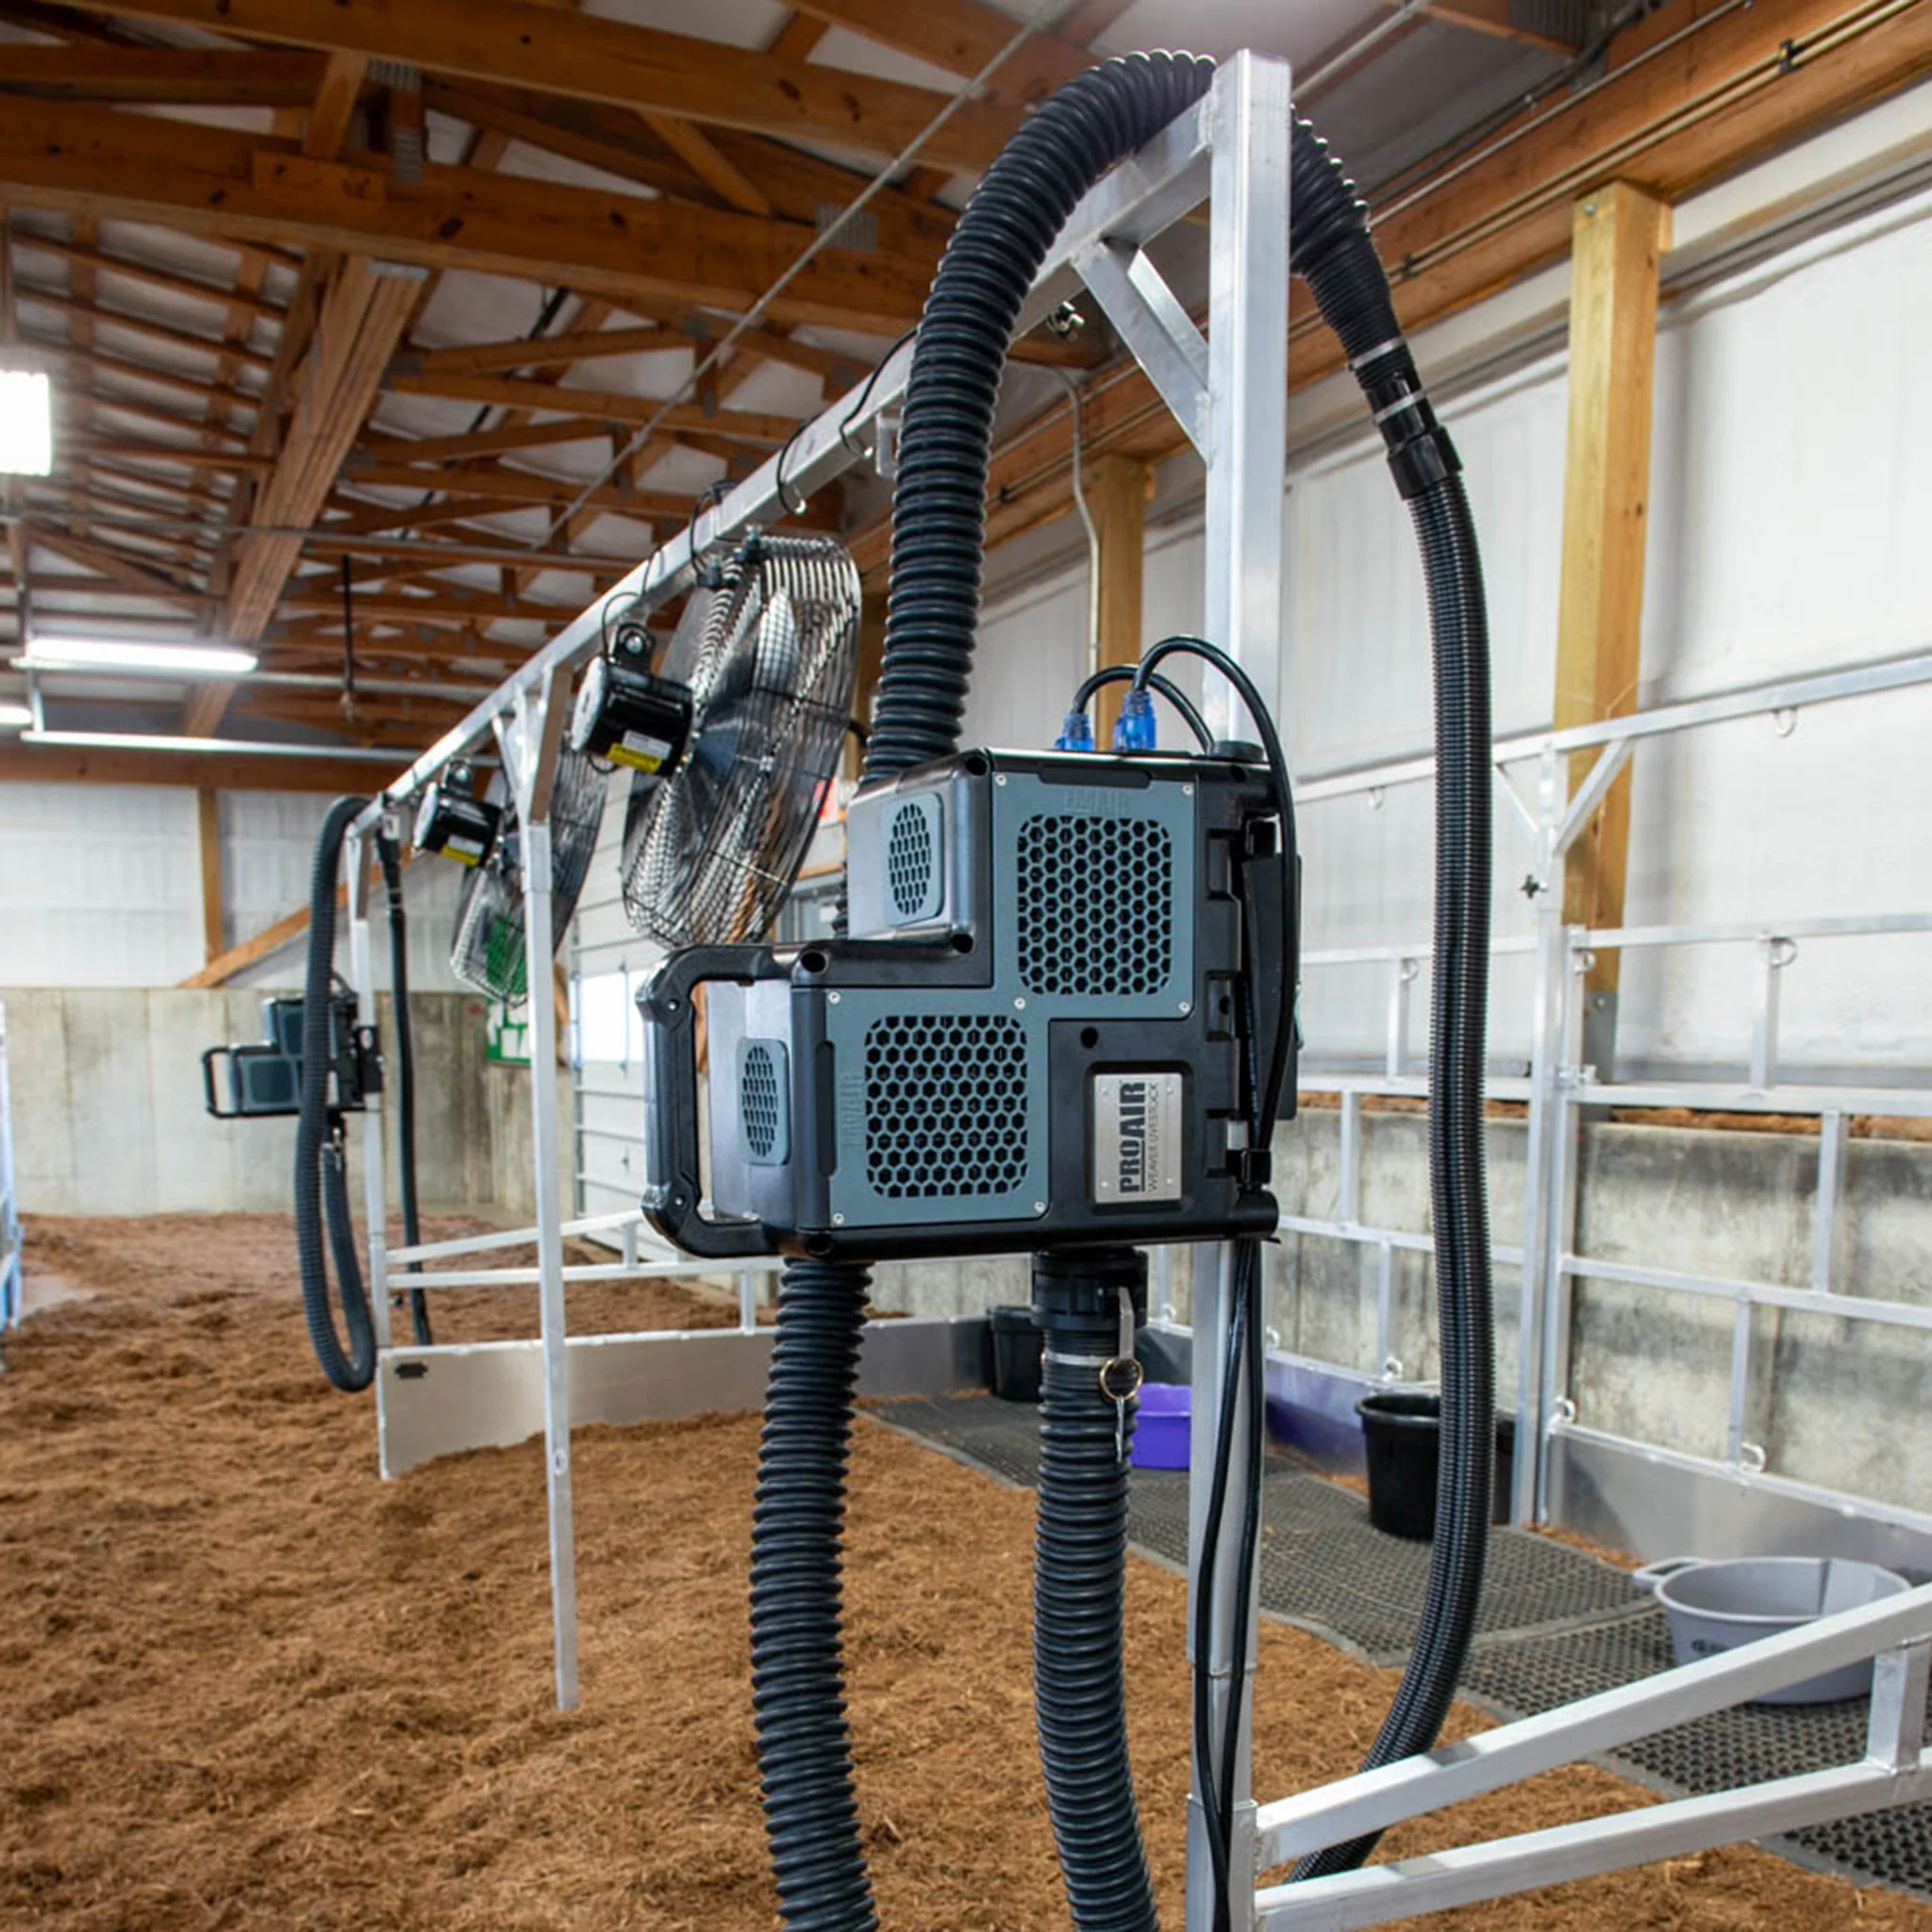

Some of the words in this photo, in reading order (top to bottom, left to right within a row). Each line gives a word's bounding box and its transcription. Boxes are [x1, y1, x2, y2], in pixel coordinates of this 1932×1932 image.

[1120, 1082, 1145, 1192] PROAIR
[1148, 1082, 1159, 1141] LIVESTOCK
[1148, 1143, 1159, 1191] WEAVER
